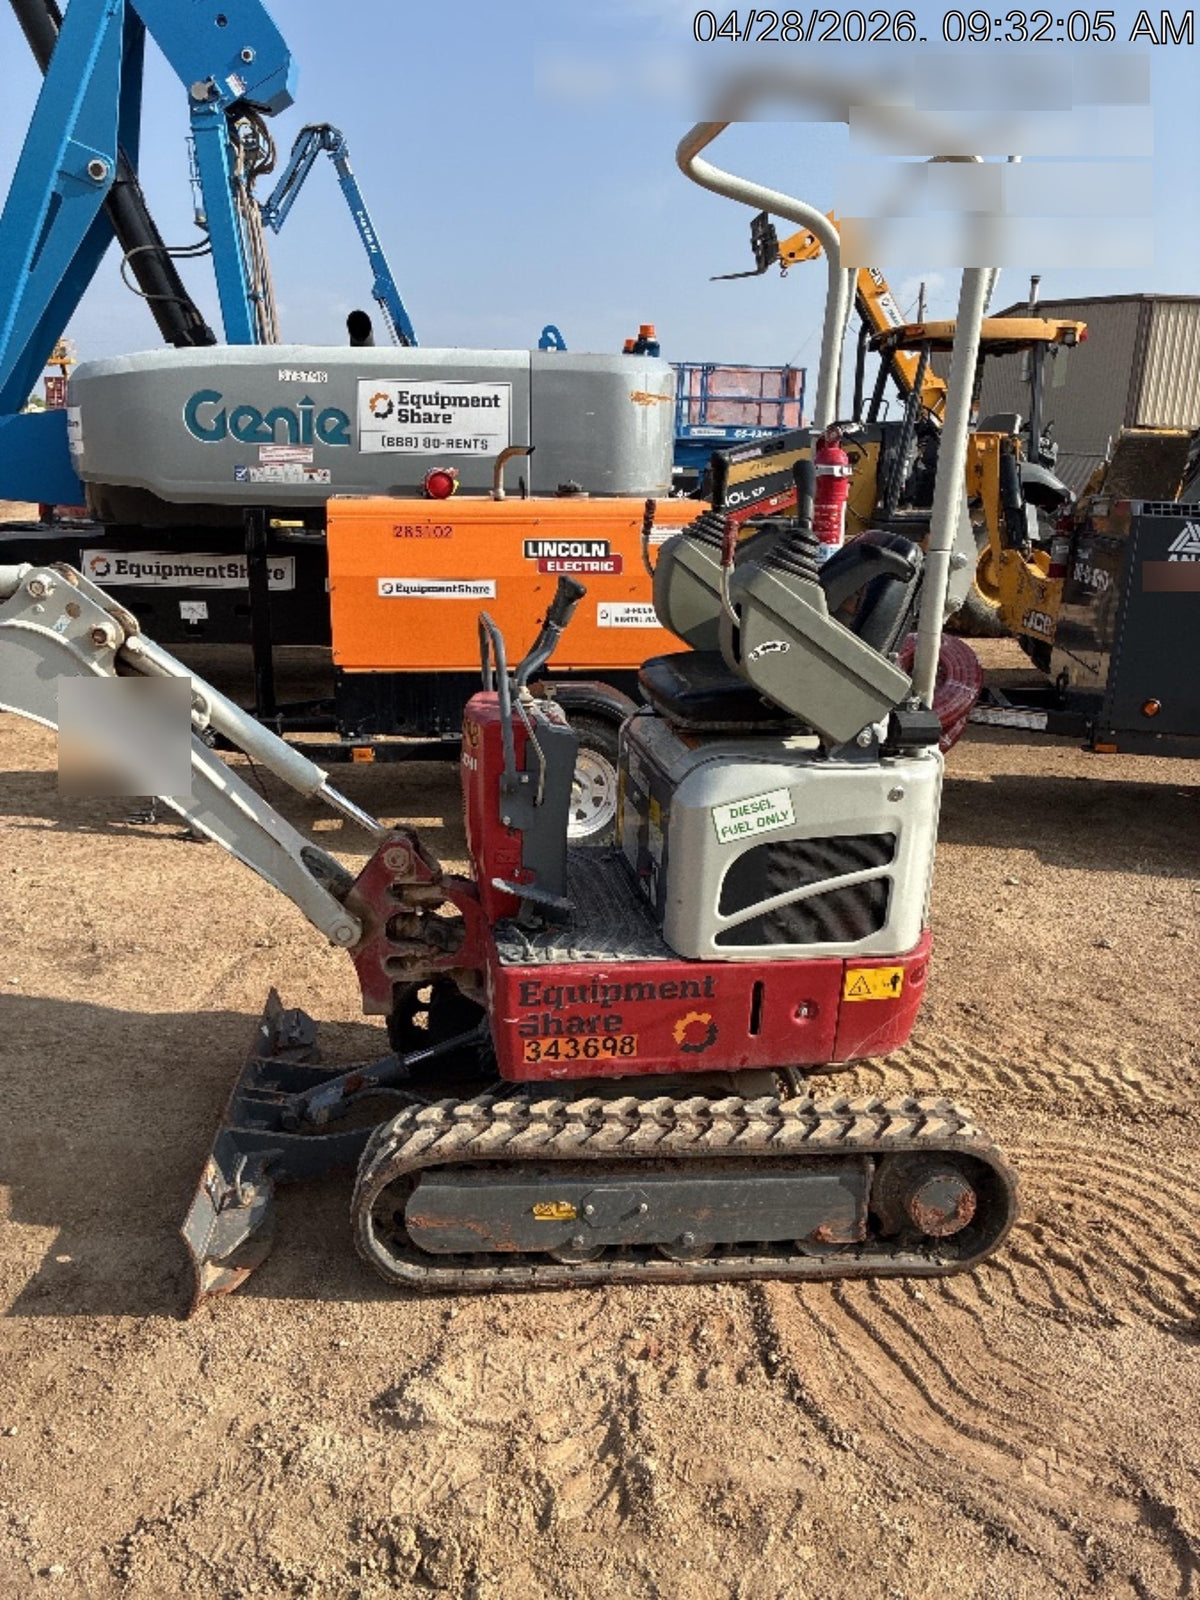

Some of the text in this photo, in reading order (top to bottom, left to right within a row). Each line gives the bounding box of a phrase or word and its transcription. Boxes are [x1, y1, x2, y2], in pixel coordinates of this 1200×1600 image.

[397, 390, 501, 410] Equipment
[182, 389, 351, 447] Genie
[397, 408, 454, 424] Share
[528, 541, 606, 558] LINCOLN
[115, 558, 286, 580] EquipmentShre
[546, 560, 615, 572] ELECTRIC
[395, 582, 491, 596] EquipmentShare
[729, 798, 775, 818] DIESEL
[721, 810, 788, 838] FUEL ONLY
[518, 975, 717, 1011] Equipment
[518, 1012, 623, 1038] Share
[525, 1035, 635, 1063] 343698
